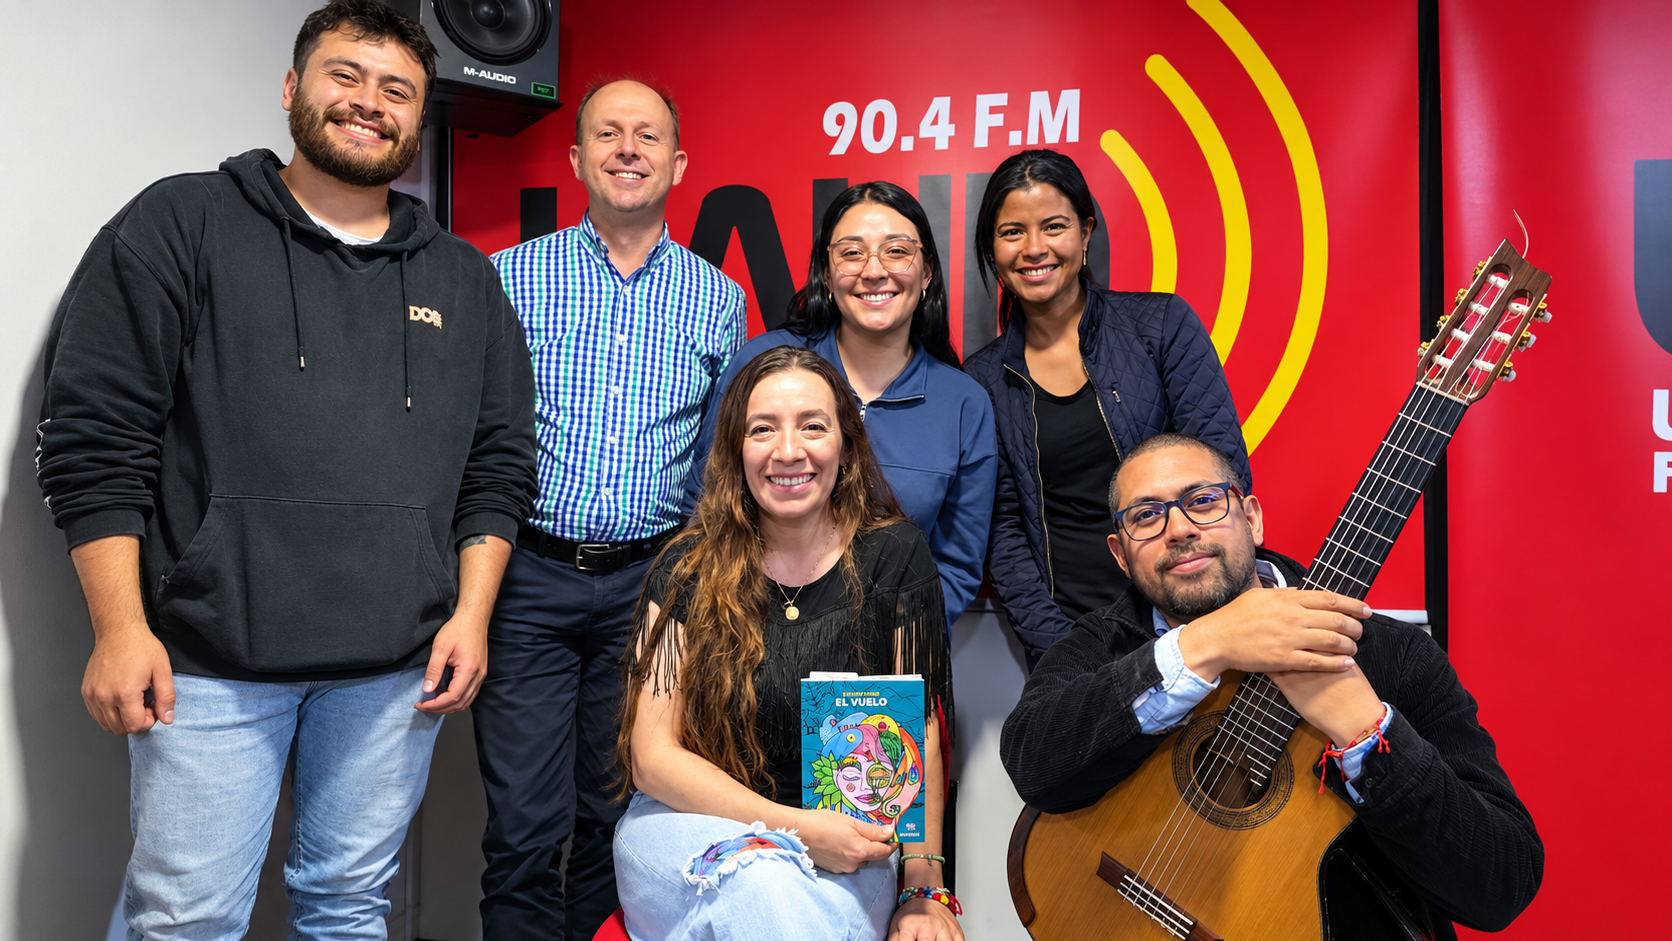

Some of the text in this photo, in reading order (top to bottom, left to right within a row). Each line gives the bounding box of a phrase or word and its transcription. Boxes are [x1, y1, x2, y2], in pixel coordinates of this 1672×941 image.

[463, 66, 517, 85] M-AUDIO
[822, 89, 1081, 156] 90.4 F.M
[835, 697, 888, 707] EL VUELO
